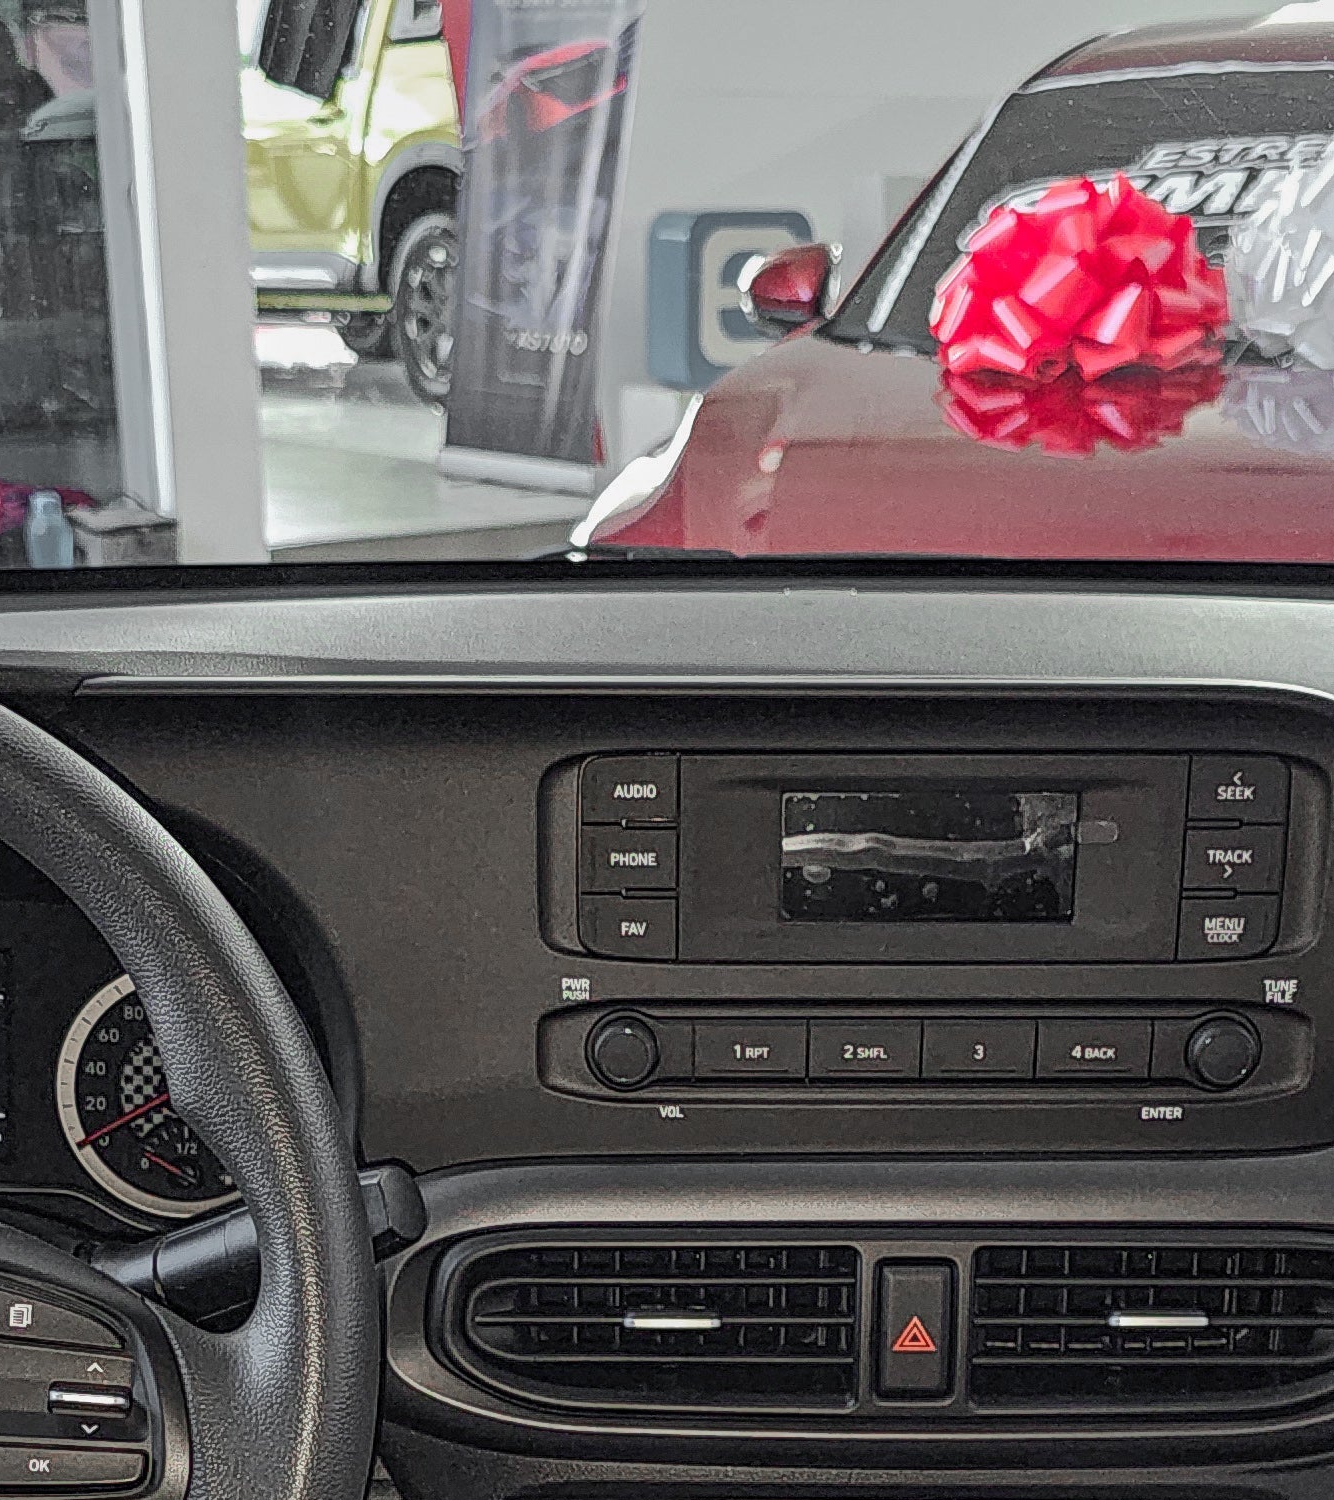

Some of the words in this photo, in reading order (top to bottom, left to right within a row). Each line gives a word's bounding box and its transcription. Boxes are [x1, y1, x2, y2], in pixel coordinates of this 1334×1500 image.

[1144, 138, 1329, 170] ESTRE
[613, 784, 657, 799] AUDIO
[1216, 785, 1255, 800] SEEK
[610, 852, 657, 867] PHONE
[1206, 849, 1253, 864] TRACK
[620, 921, 647, 936] FAV
[1204, 917, 1246, 932] MENU
[1207, 933, 1240, 944] CLOCK
[561, 976, 590, 991] PWR
[1263, 979, 1298, 993] TUNE
[562, 990, 590, 1001] PUSH
[1265, 992, 1294, 1004] FILE
[123, 1005, 144, 1021] 80
[97, 1027, 120, 1043] 60
[733, 1044, 741, 1059] 1
[745, 1047, 770, 1059] RPT
[843, 1044, 854, 1059] 2
[856, 1047, 888, 1059] SHFL
[973, 1044, 984, 1060] 3
[1071, 1044, 1082, 1059] 4
[1084, 1047, 1117, 1060] BACK
[84, 1060, 106, 1076] 40
[84, 1095, 107, 1111] 20
[658, 1104, 684, 1119] VOL
[1140, 1106, 1183, 1120] ENTER
[28, 1458, 51, 1473] OK
